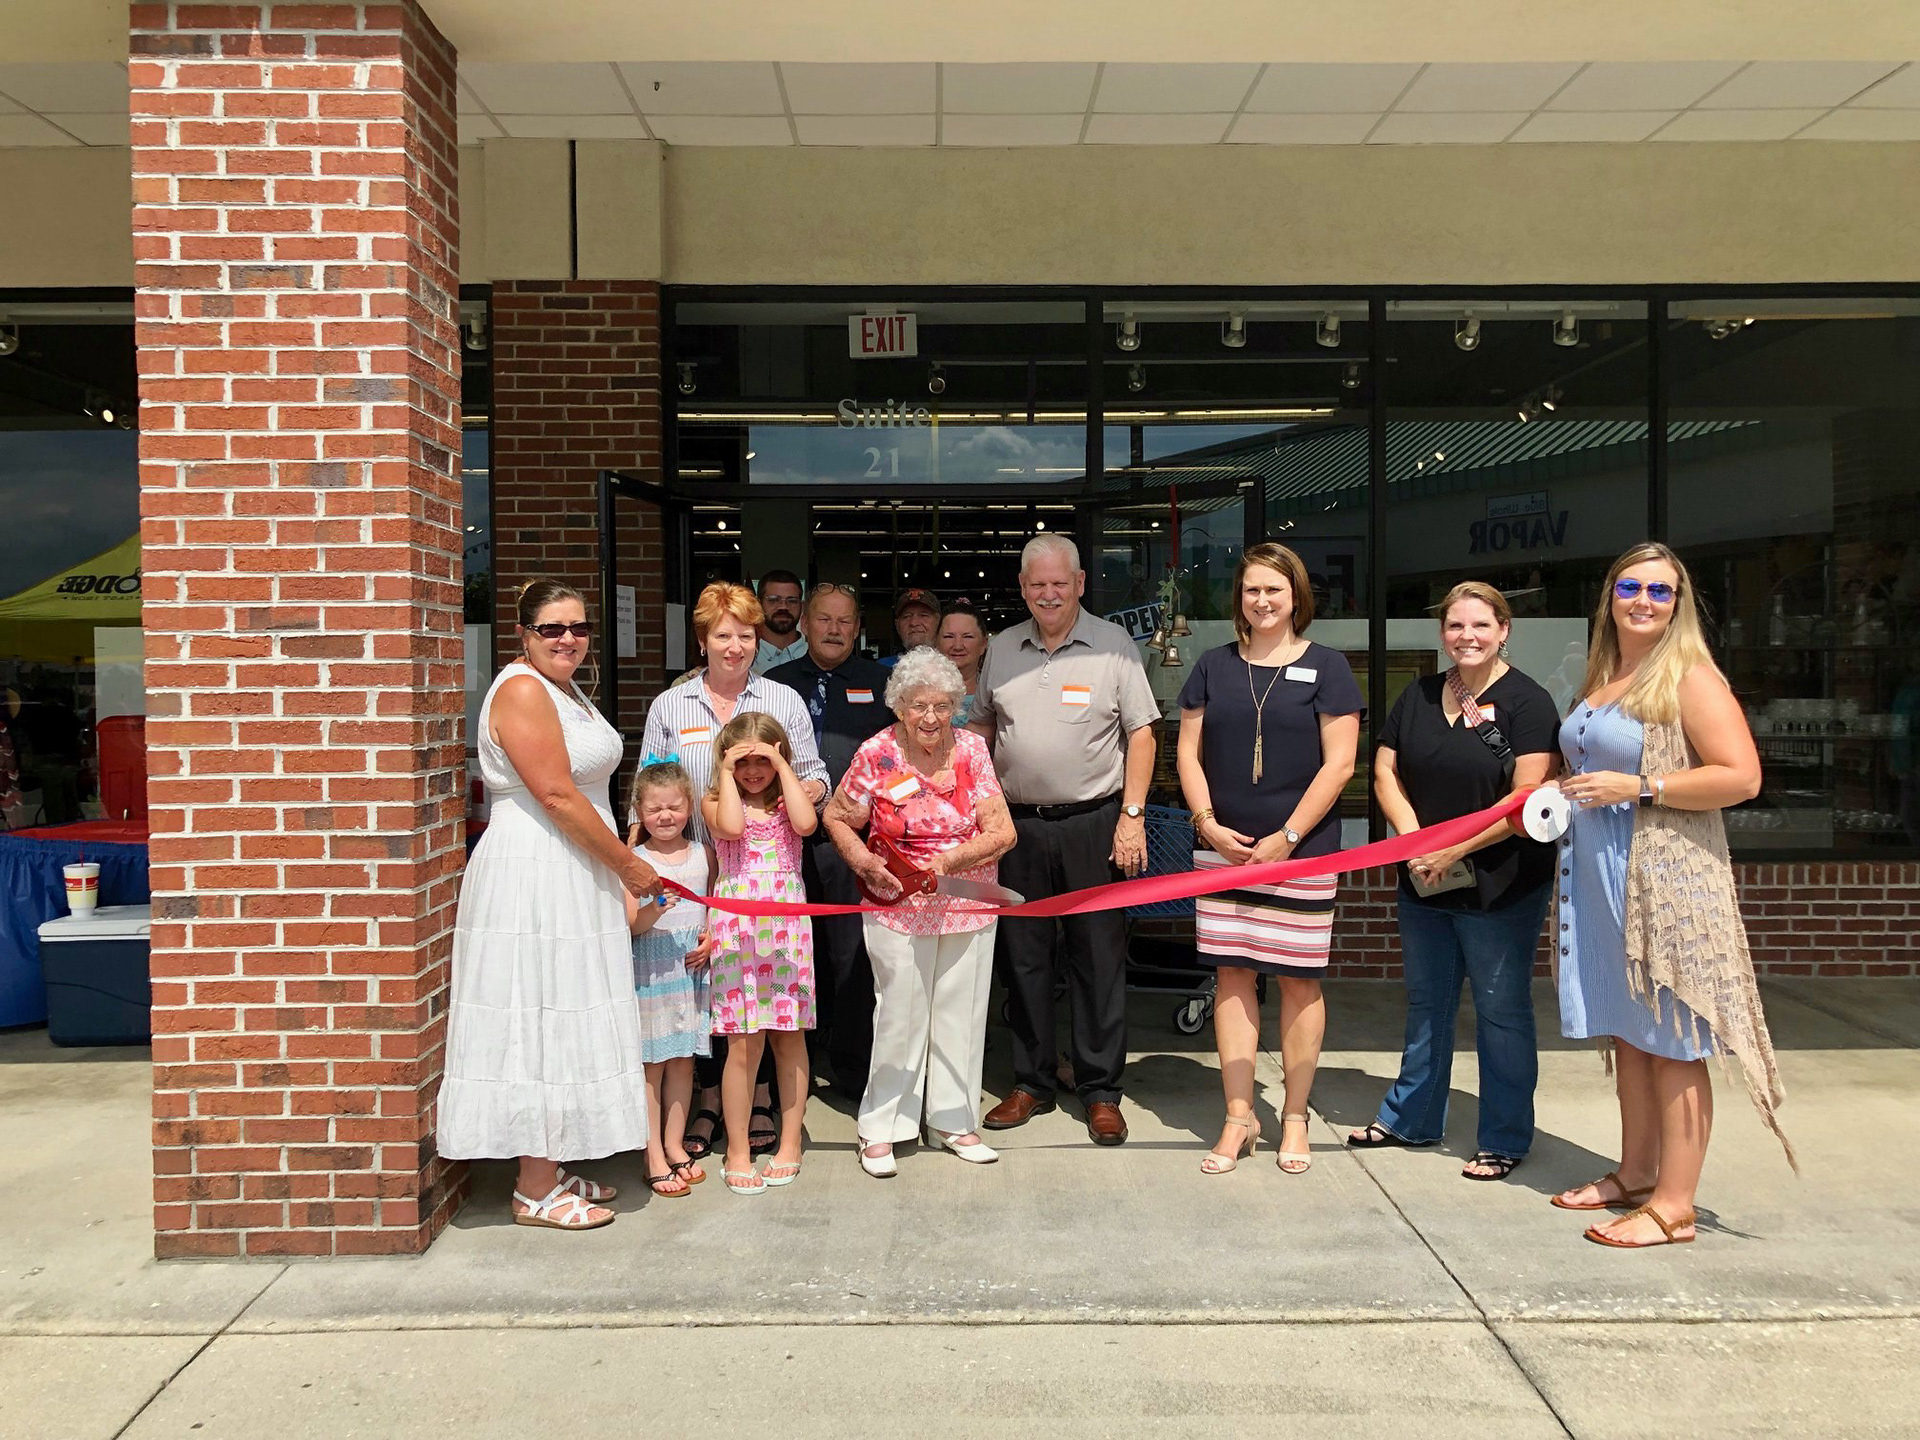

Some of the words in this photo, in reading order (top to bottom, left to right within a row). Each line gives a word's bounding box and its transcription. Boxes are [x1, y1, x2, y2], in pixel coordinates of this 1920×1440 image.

[861, 316, 907, 353] EXIT
[837, 398, 931, 430] Suite
[863, 447, 900, 478] 21
